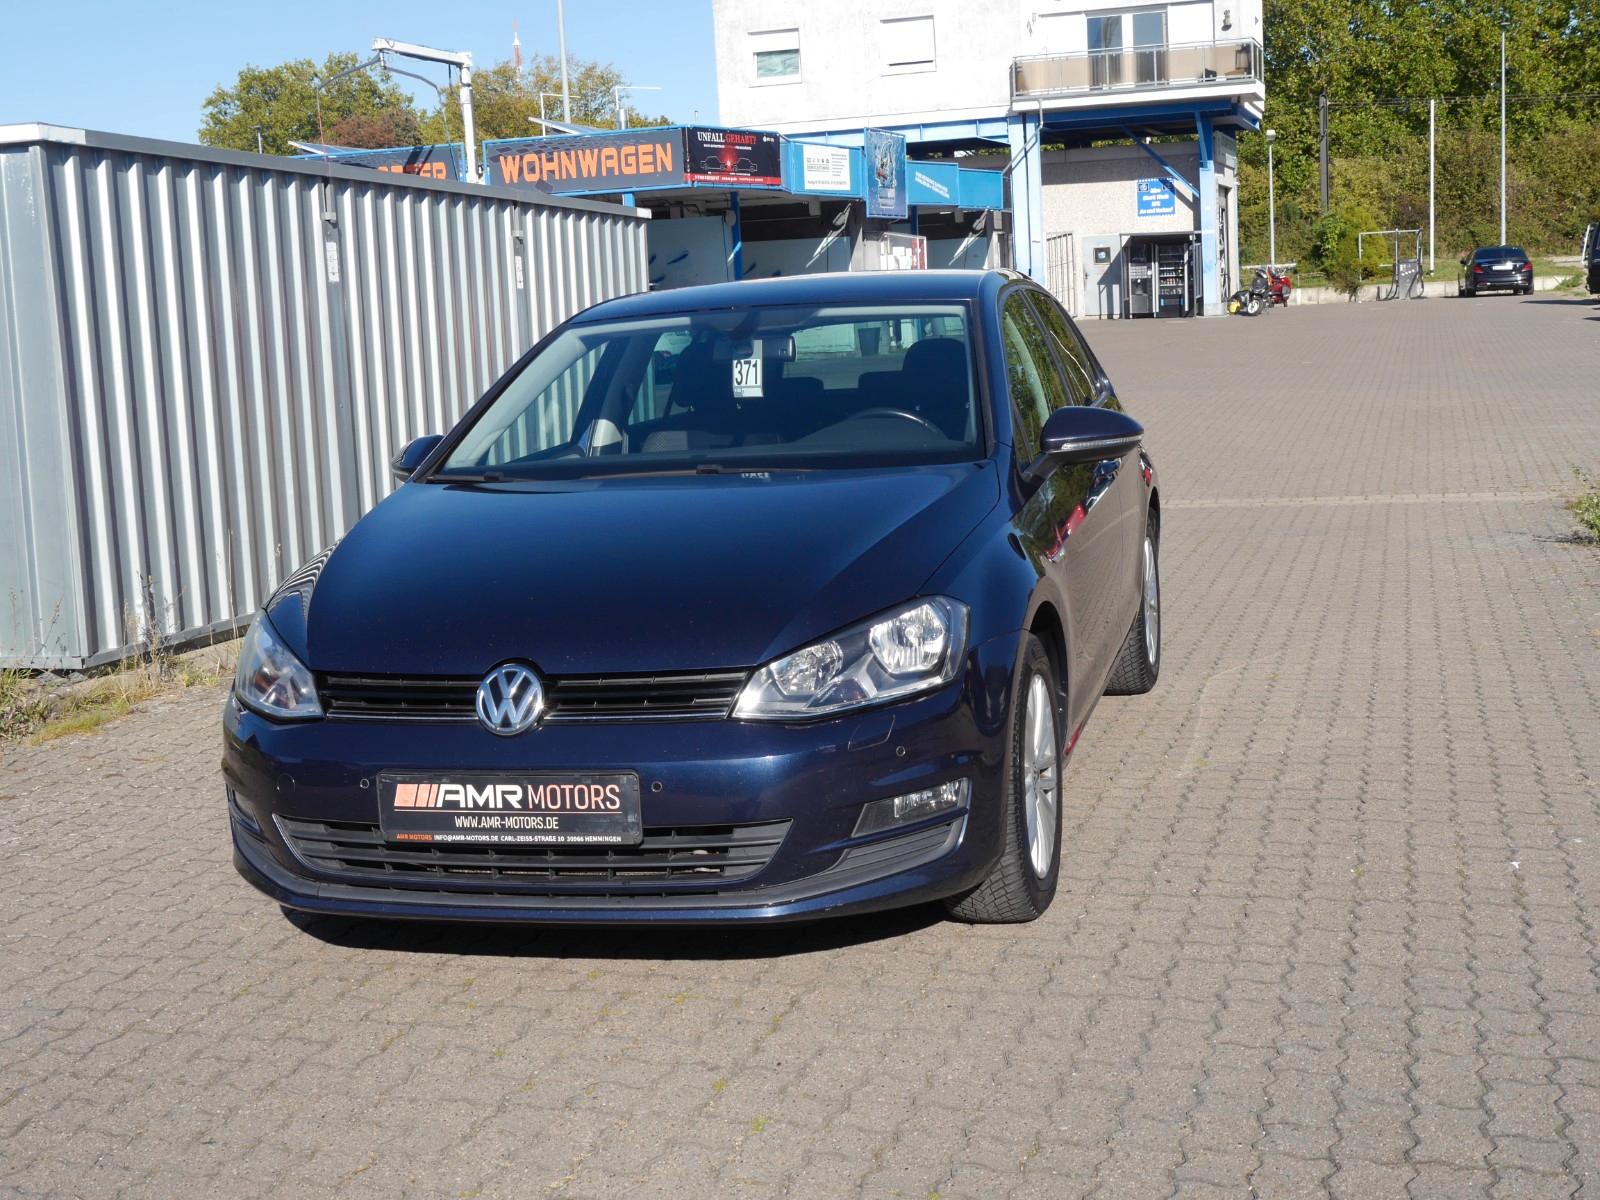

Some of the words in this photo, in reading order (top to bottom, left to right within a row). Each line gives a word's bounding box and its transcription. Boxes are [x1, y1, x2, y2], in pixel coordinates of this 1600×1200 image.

[697, 131, 725, 143] UNFALL
[499, 143, 673, 183] WOHNWAGEN
[735, 359, 758, 386] 371
[436, 784, 522, 808] AMR
[528, 784, 620, 809] MOTORS
[454, 815, 559, 829] WWW.AMR-MOTORS.DE
[433, 834, 499, 842] INFO@AMR-MOTORS.DE
